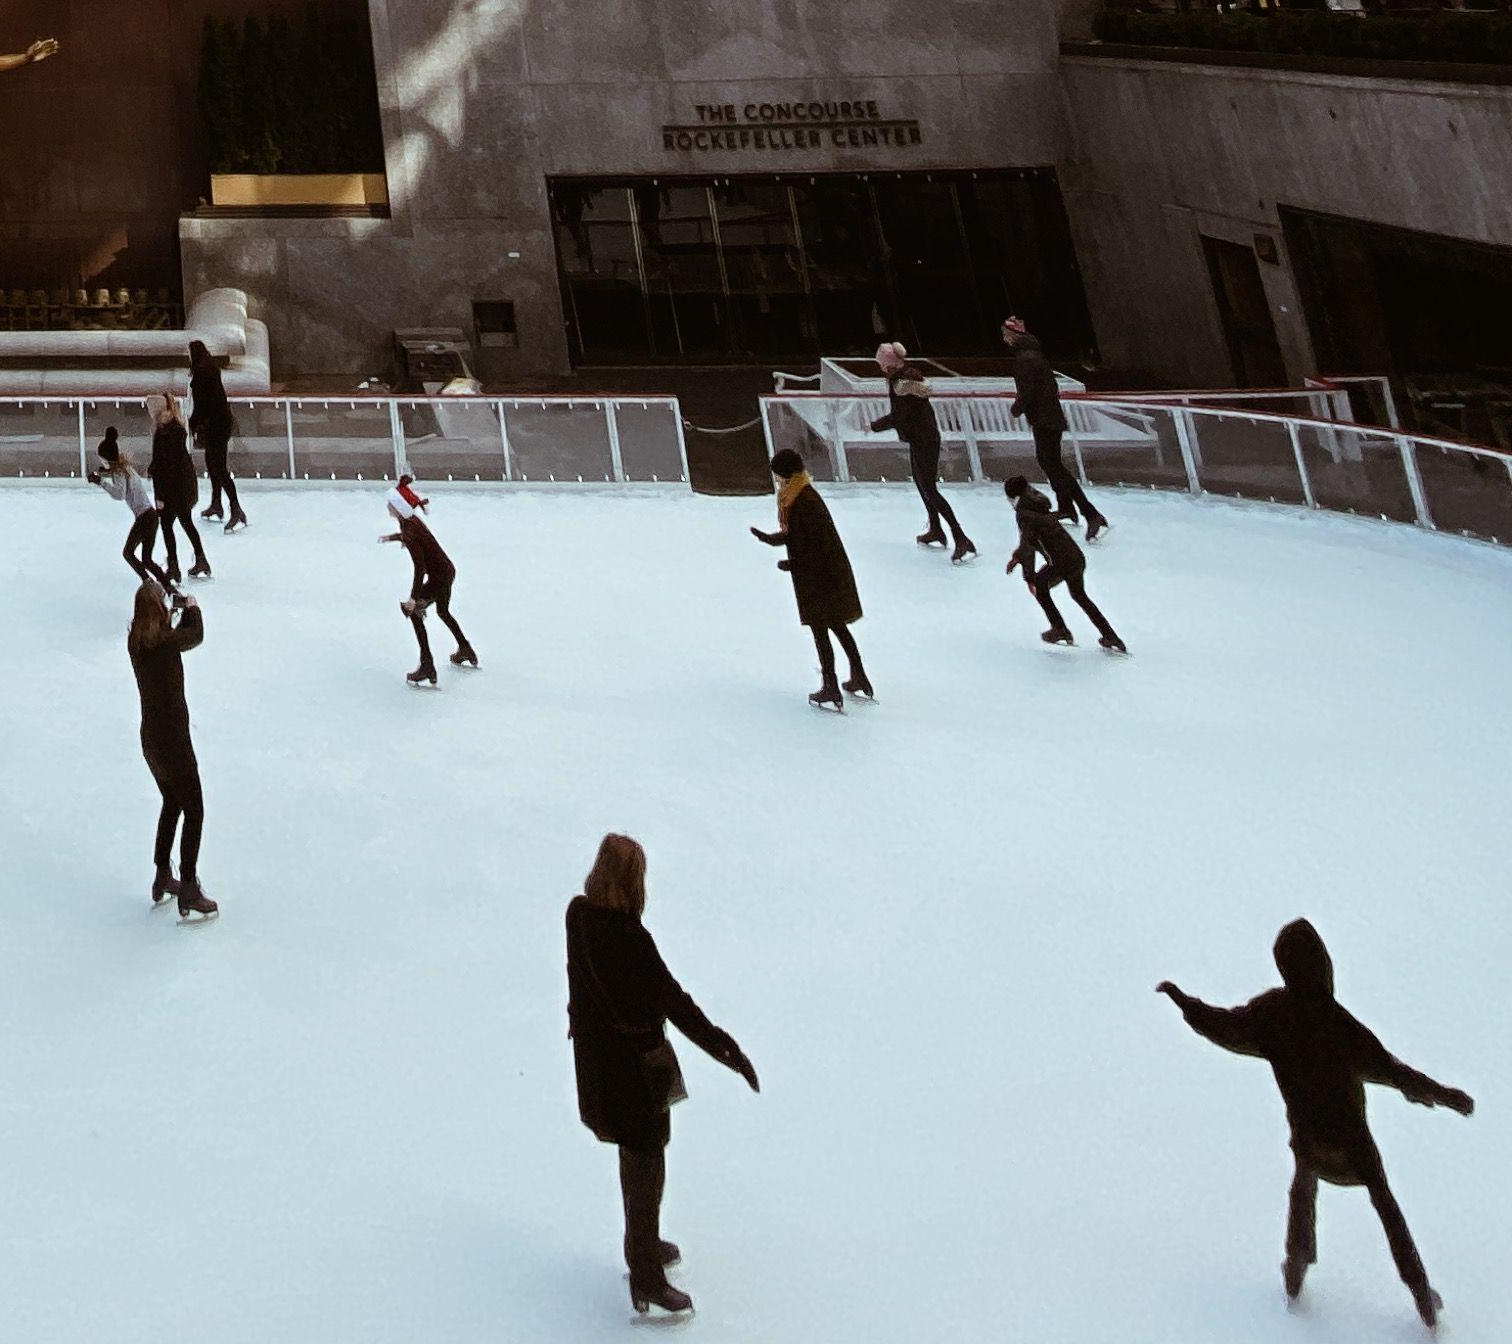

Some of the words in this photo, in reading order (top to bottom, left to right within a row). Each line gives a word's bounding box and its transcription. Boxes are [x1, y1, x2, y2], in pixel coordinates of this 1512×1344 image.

[694, 103, 737, 122] THE
[743, 100, 881, 121] CONCOURSE
[662, 129, 821, 152] ROCKEFELLER
[831, 126, 923, 149] CENTER
